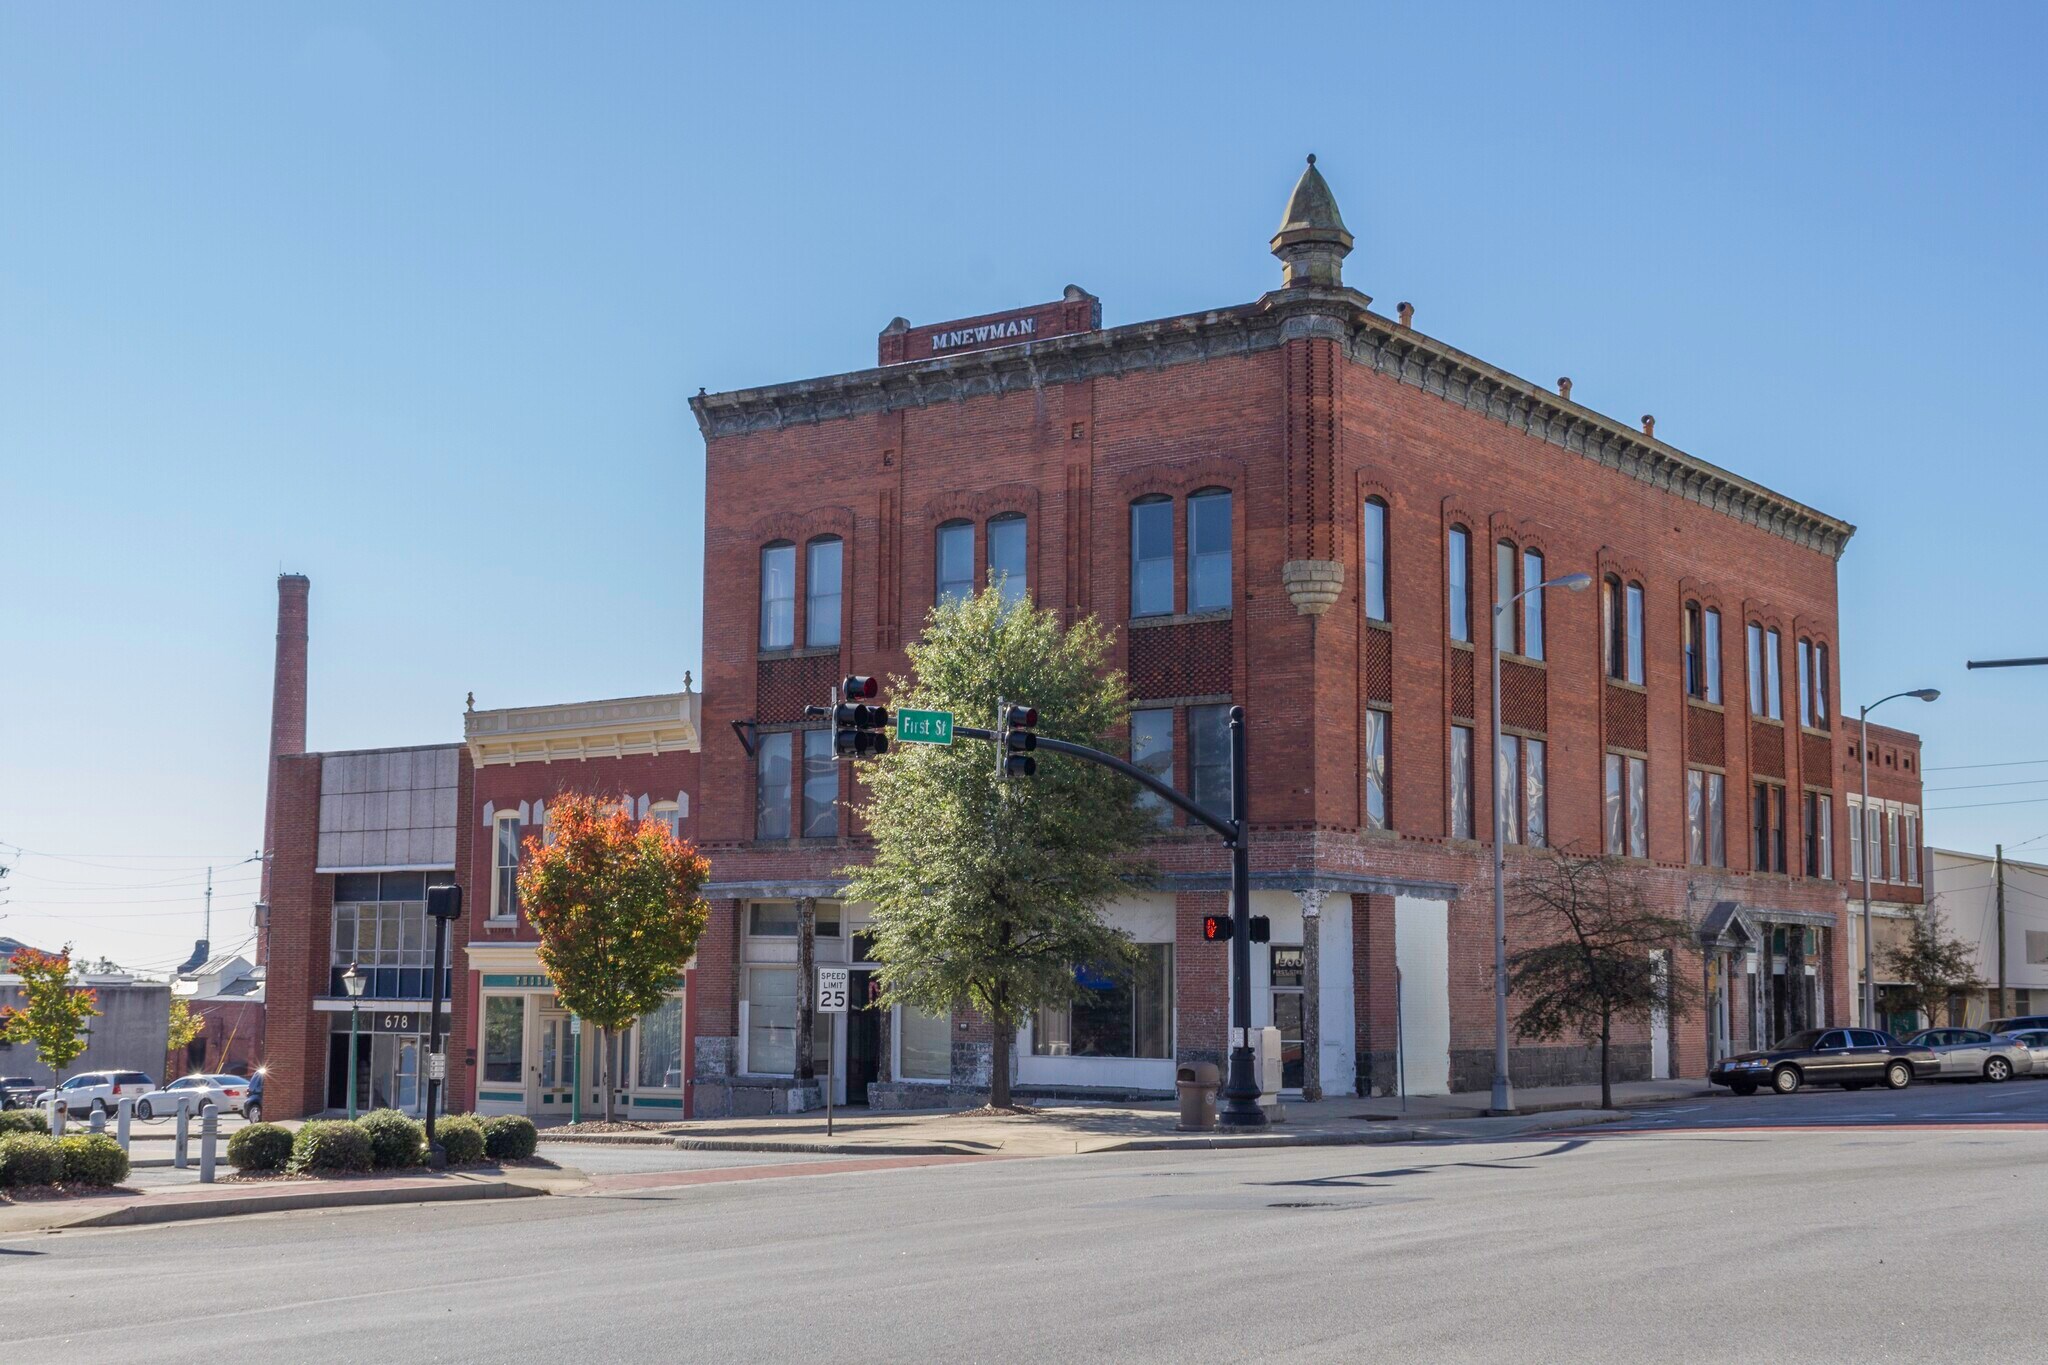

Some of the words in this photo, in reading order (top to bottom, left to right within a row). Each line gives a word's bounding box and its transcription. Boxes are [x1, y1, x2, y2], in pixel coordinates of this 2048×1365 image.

[904, 716, 930, 735] First
[935, 719, 947, 736] St
[821, 972, 847, 980] SPEED
[823, 981, 844, 989] LIMIT
[820, 991, 846, 1008] 25
[384, 1014, 409, 1029] 678
